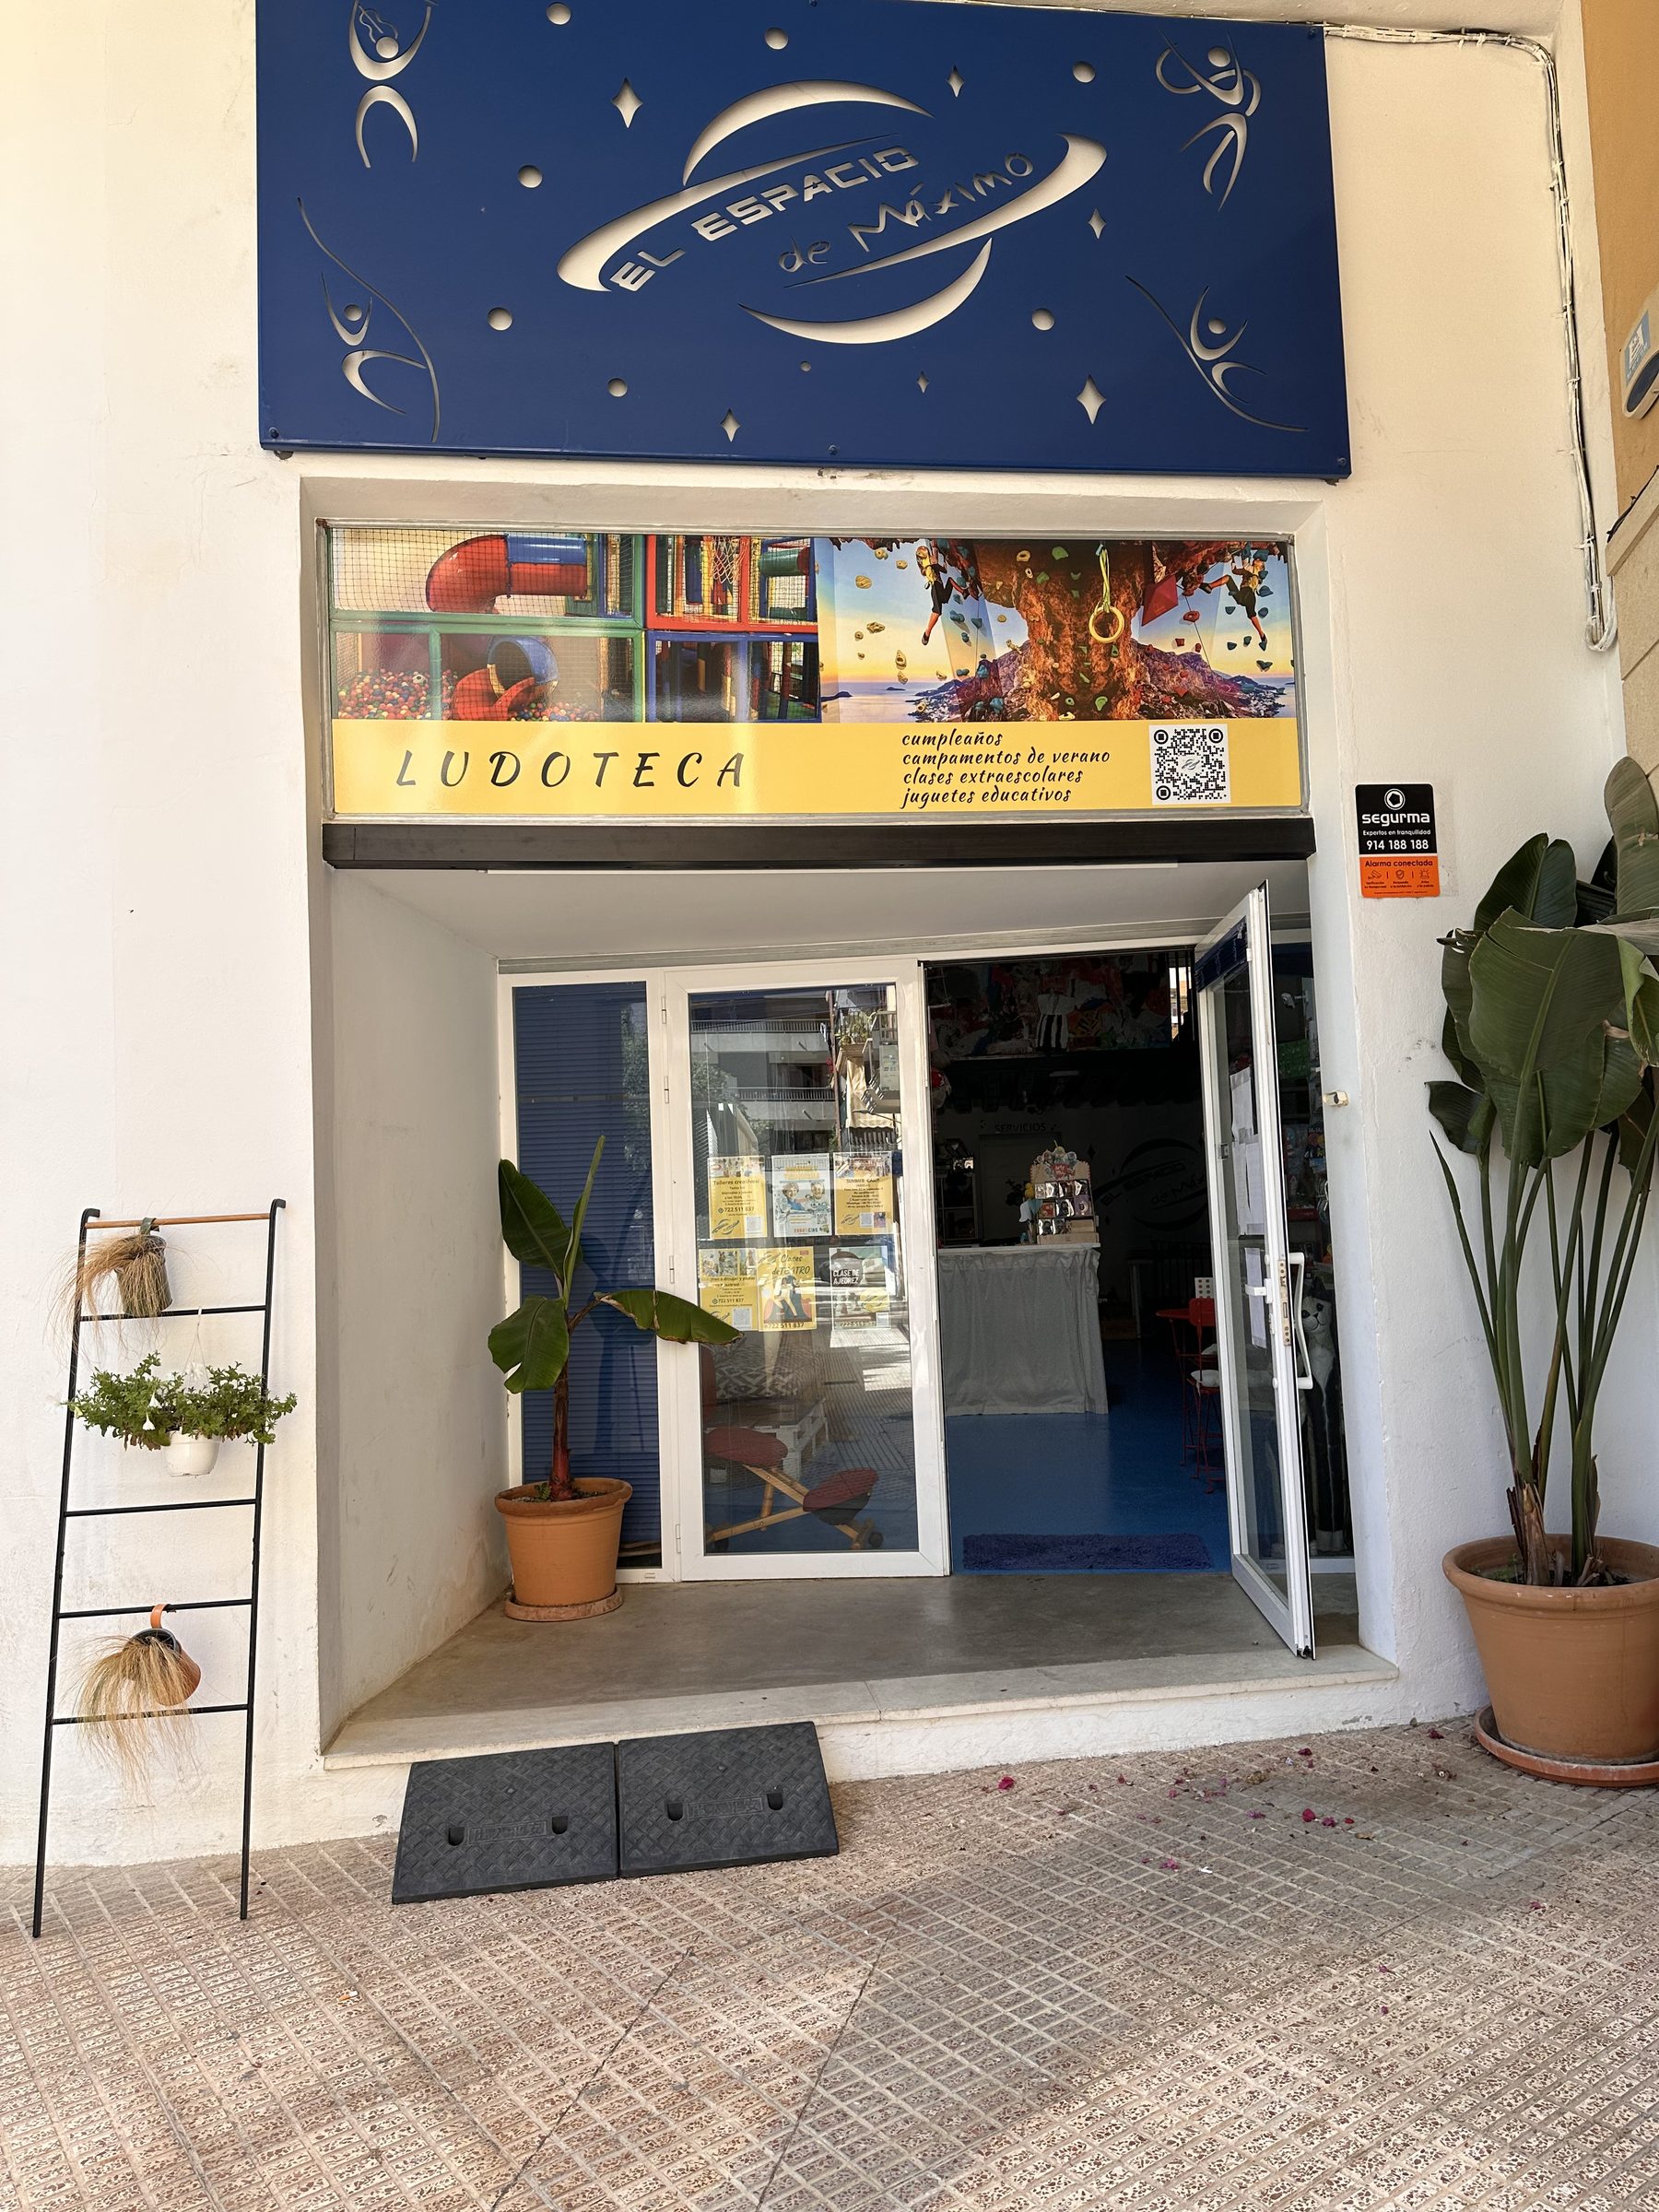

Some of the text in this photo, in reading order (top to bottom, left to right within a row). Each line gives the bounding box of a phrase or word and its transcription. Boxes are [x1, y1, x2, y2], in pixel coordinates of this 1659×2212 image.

[609, 145, 920, 292] EL ESPACIO
[778, 152, 1034, 273] de Máximo
[901, 728, 1003, 750] cumpleaños
[395, 749, 745, 788] LUDOTECA
[902, 747, 1111, 771] campamentos de verano
[903, 764, 1084, 785] clases extraescolares
[899, 784, 1072, 809] juguetes educativos
[1361, 813, 1430, 827] segurma
[1366, 839, 1429, 850] 914 188 188
[994, 1123, 1046, 1132] SERVICIOS
